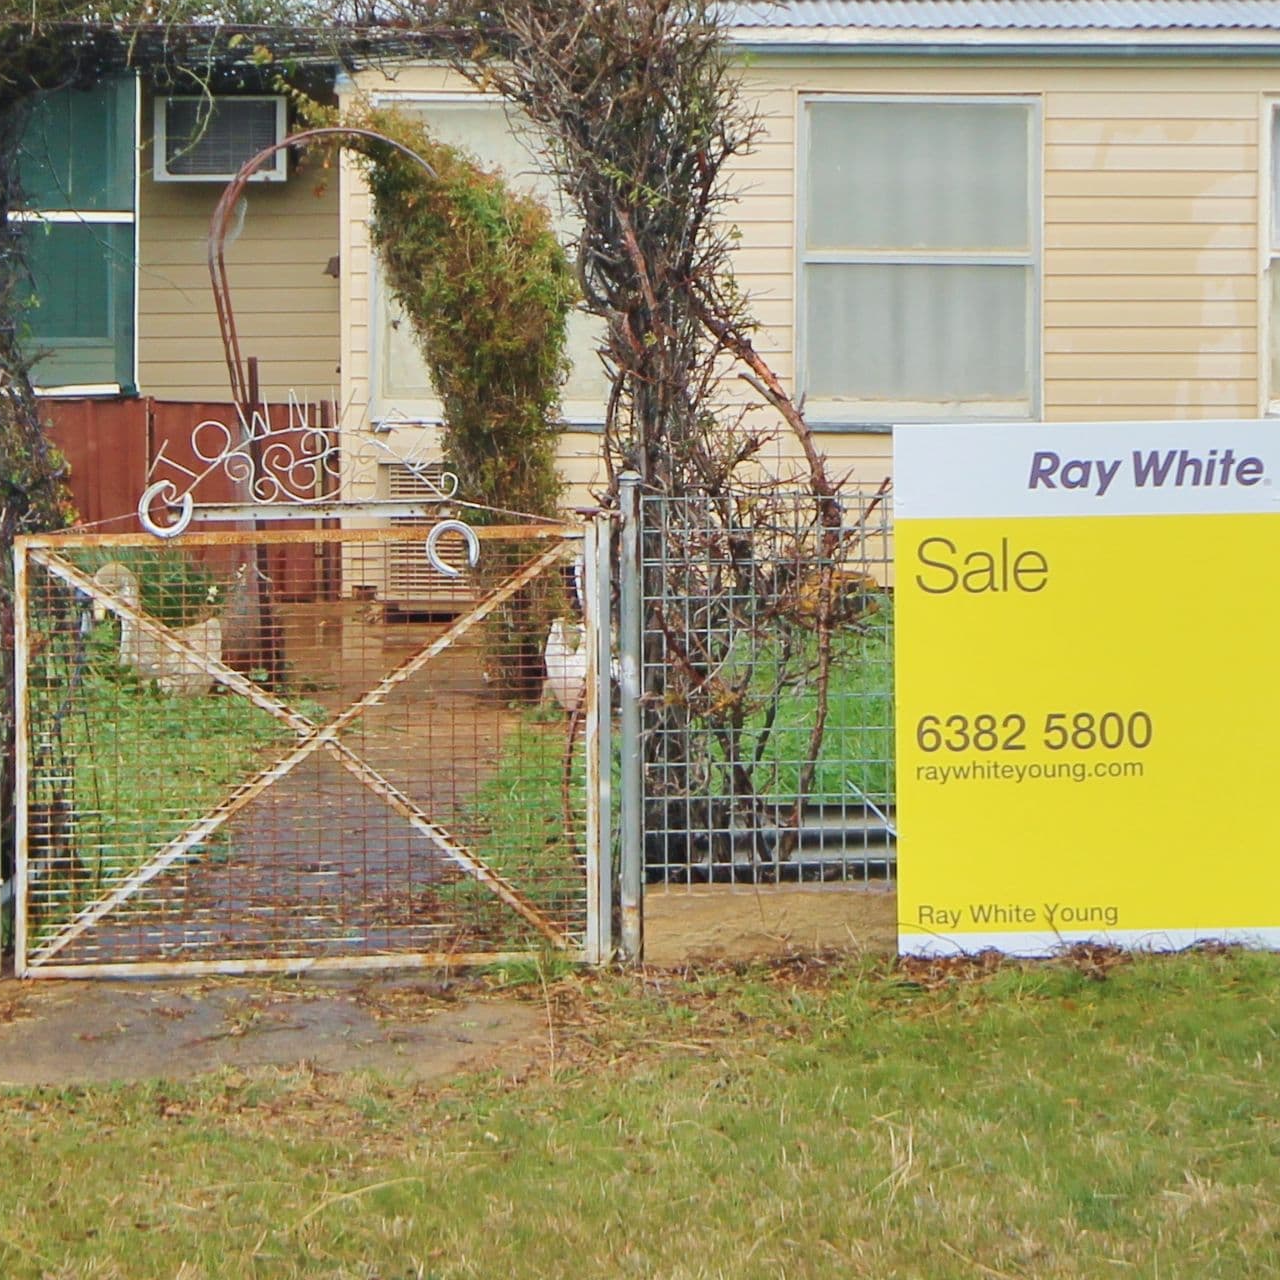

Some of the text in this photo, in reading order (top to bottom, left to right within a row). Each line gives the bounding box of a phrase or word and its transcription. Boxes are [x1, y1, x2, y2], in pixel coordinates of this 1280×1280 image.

[1028, 448, 1264, 496] Ray White
[915, 536, 1049, 594] Sale
[916, 711, 1153, 753] 6382 5800
[916, 759, 1144, 785] raywhiteyoung.com
[918, 903, 1119, 927] Ray White Young
